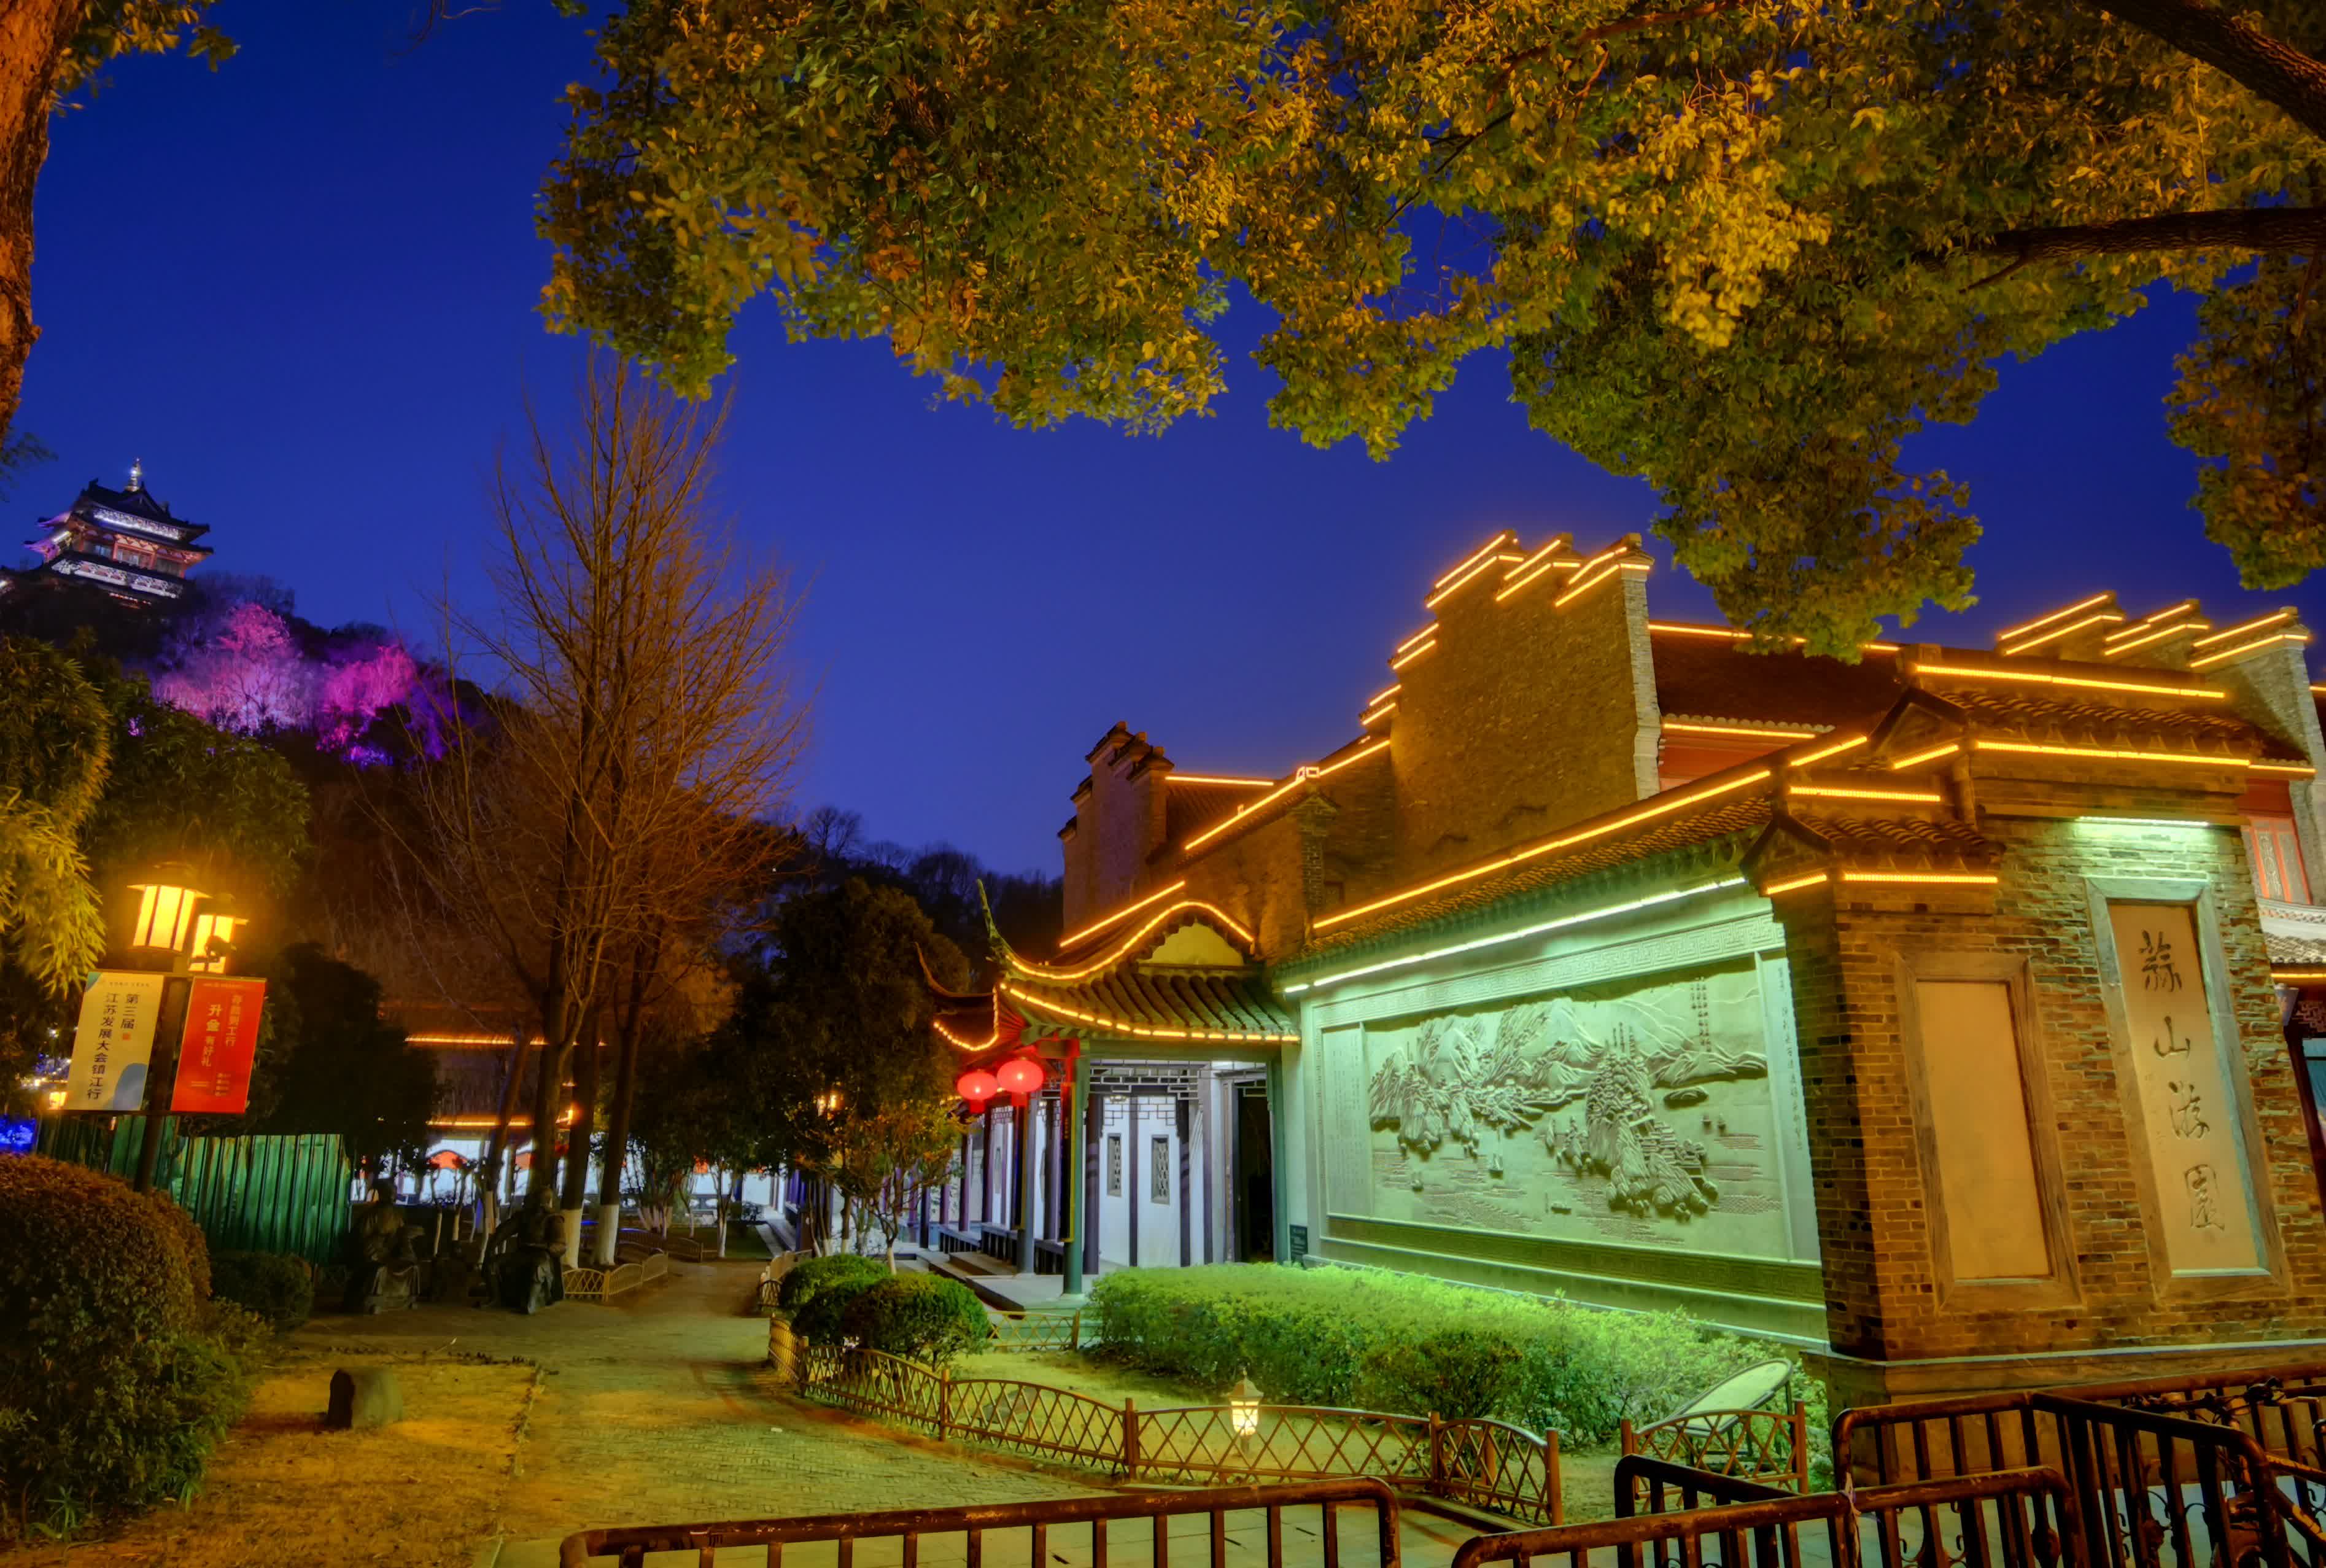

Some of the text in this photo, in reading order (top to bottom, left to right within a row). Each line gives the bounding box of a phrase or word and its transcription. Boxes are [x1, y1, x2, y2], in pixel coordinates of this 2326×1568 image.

[87, 993, 118, 1100] 江苏发展大会镇江行
[121, 993, 139, 1030] 第三届
